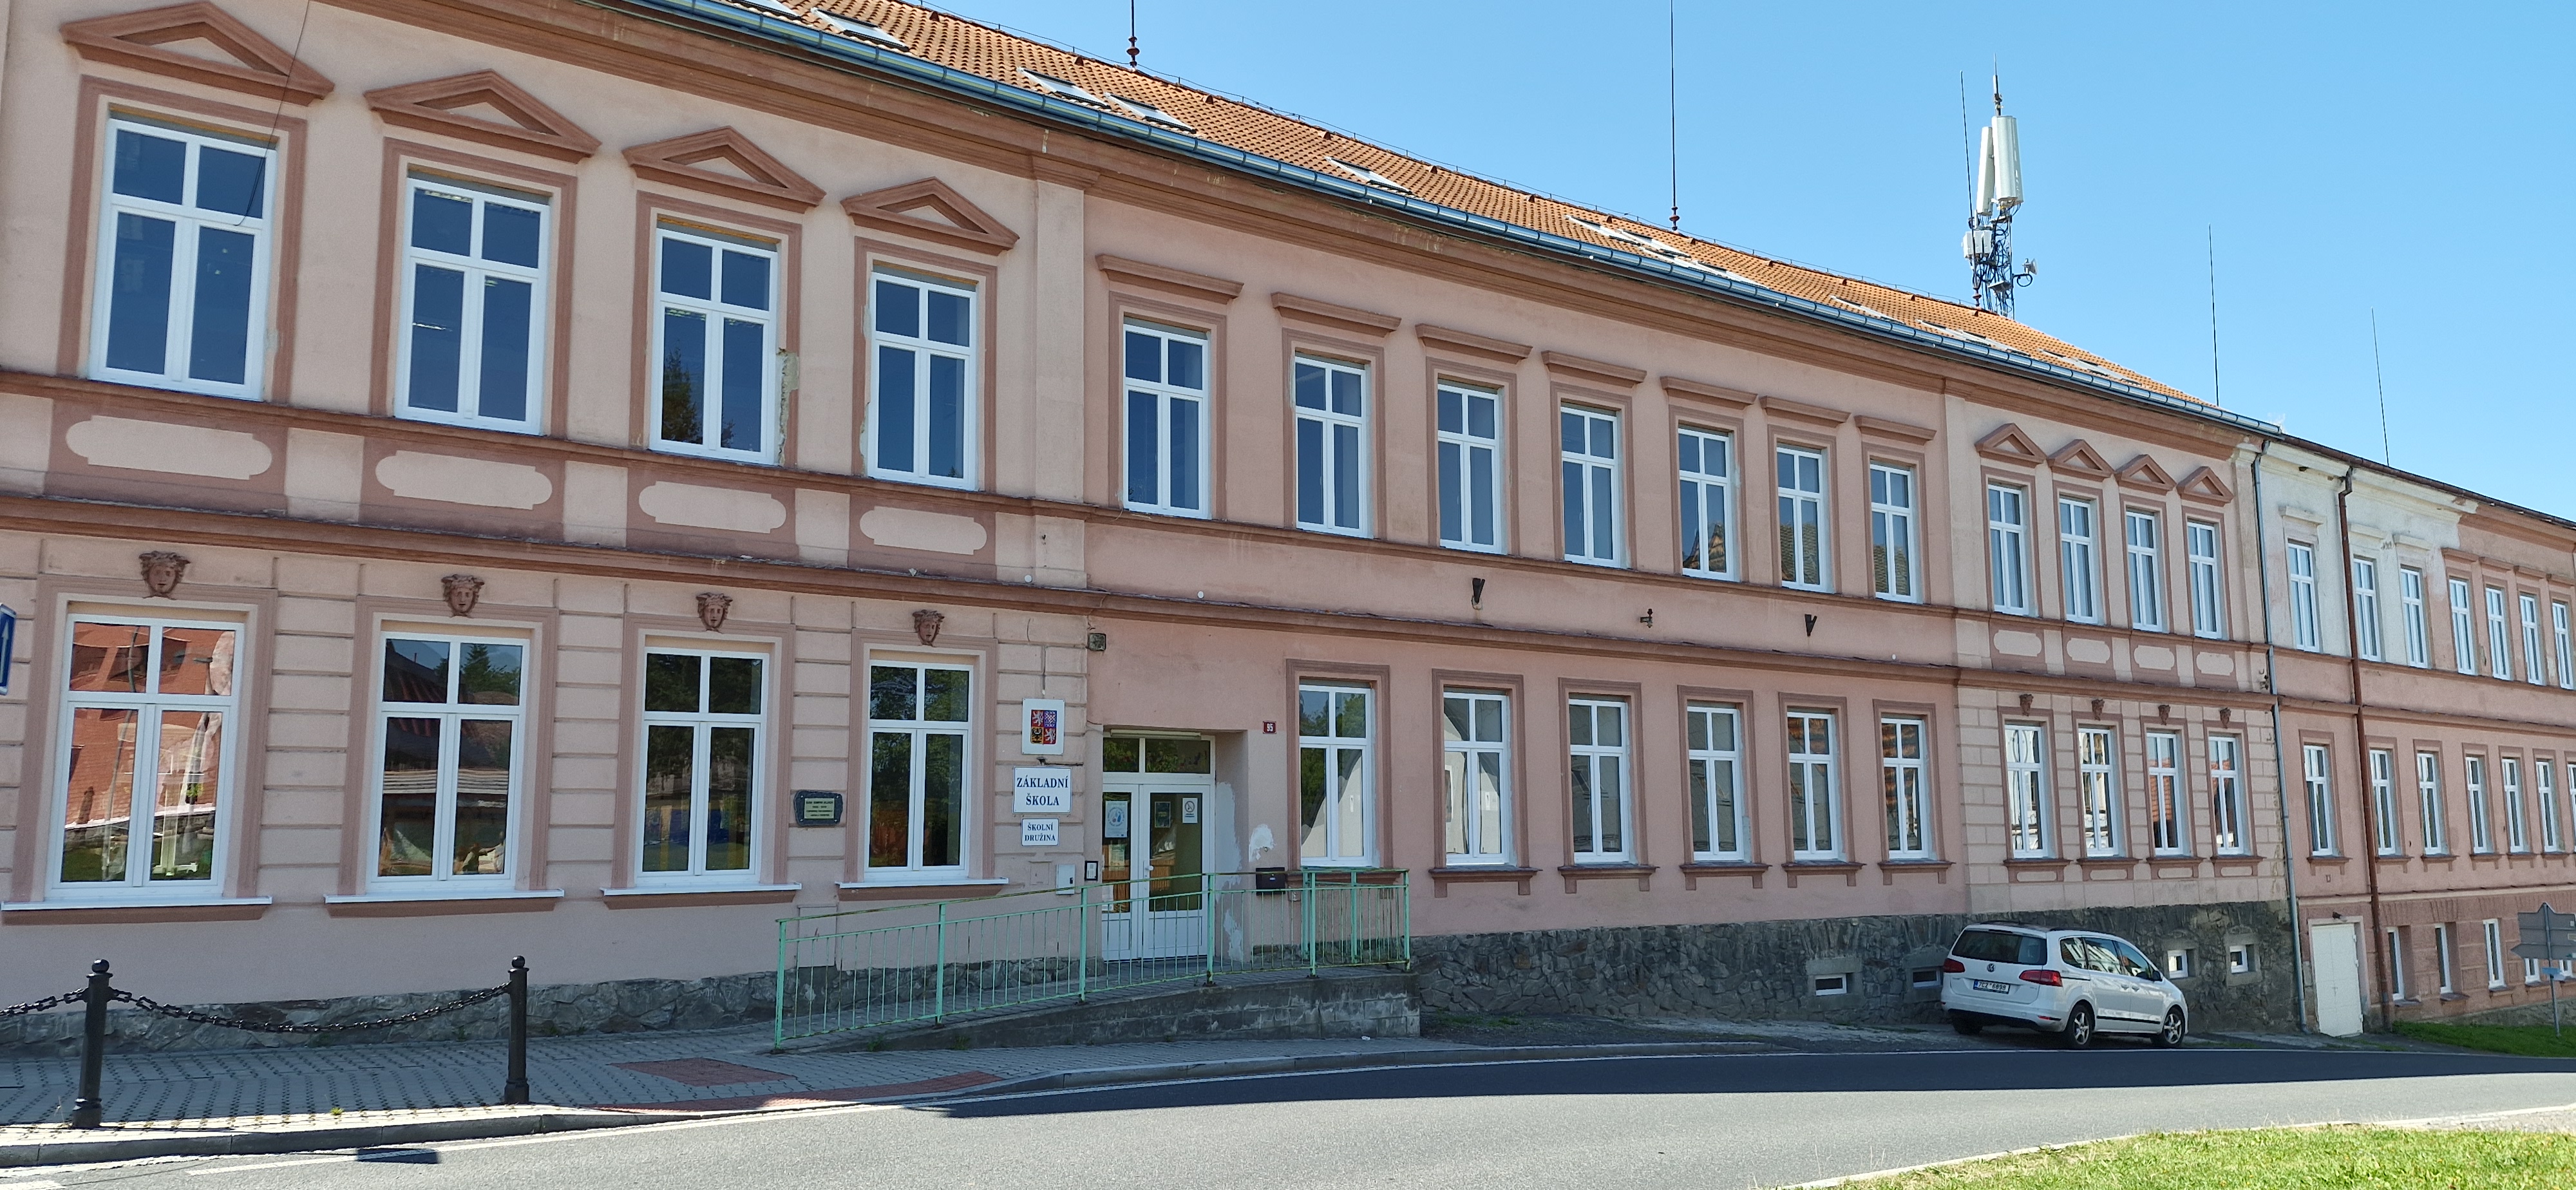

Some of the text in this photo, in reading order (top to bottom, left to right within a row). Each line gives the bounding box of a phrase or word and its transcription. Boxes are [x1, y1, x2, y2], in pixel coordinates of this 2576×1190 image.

[1267, 723, 1273, 732] 95
[1016, 775, 1068, 788] ZÁKLADNÍ
[1026, 793, 1059, 806] ŠKOLA
[1027, 822, 1053, 831] ŠKOLNÍ
[1025, 833, 1056, 841] DRUŽINA
